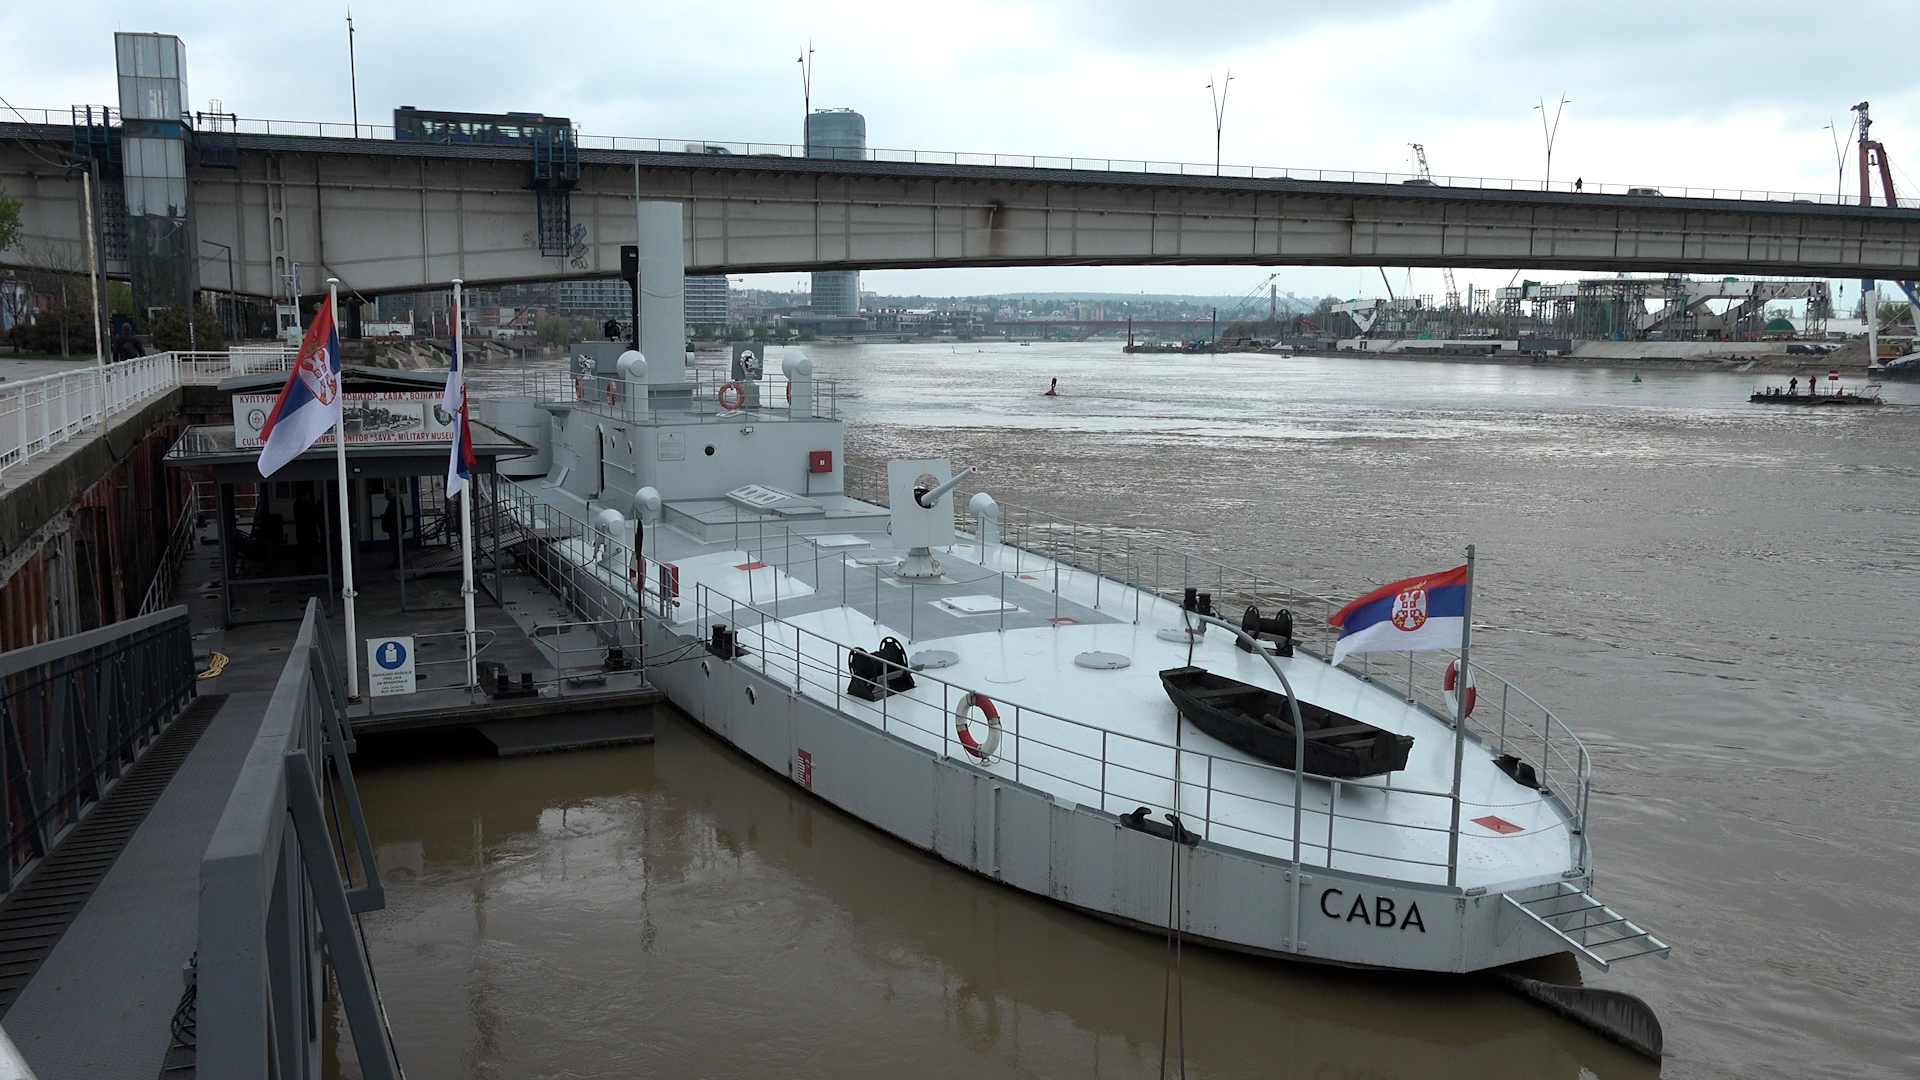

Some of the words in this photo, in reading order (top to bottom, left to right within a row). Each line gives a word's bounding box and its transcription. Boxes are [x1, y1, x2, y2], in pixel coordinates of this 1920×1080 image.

[410, 392, 434, 400] ВОЈНИ
[242, 437, 266, 446] CULTU
[344, 434, 369, 442] ONITOR
[398, 432, 429, 441] MILITARY
[431, 431, 454, 440] MUSEU
[1320, 888, 1426, 933] САВА
